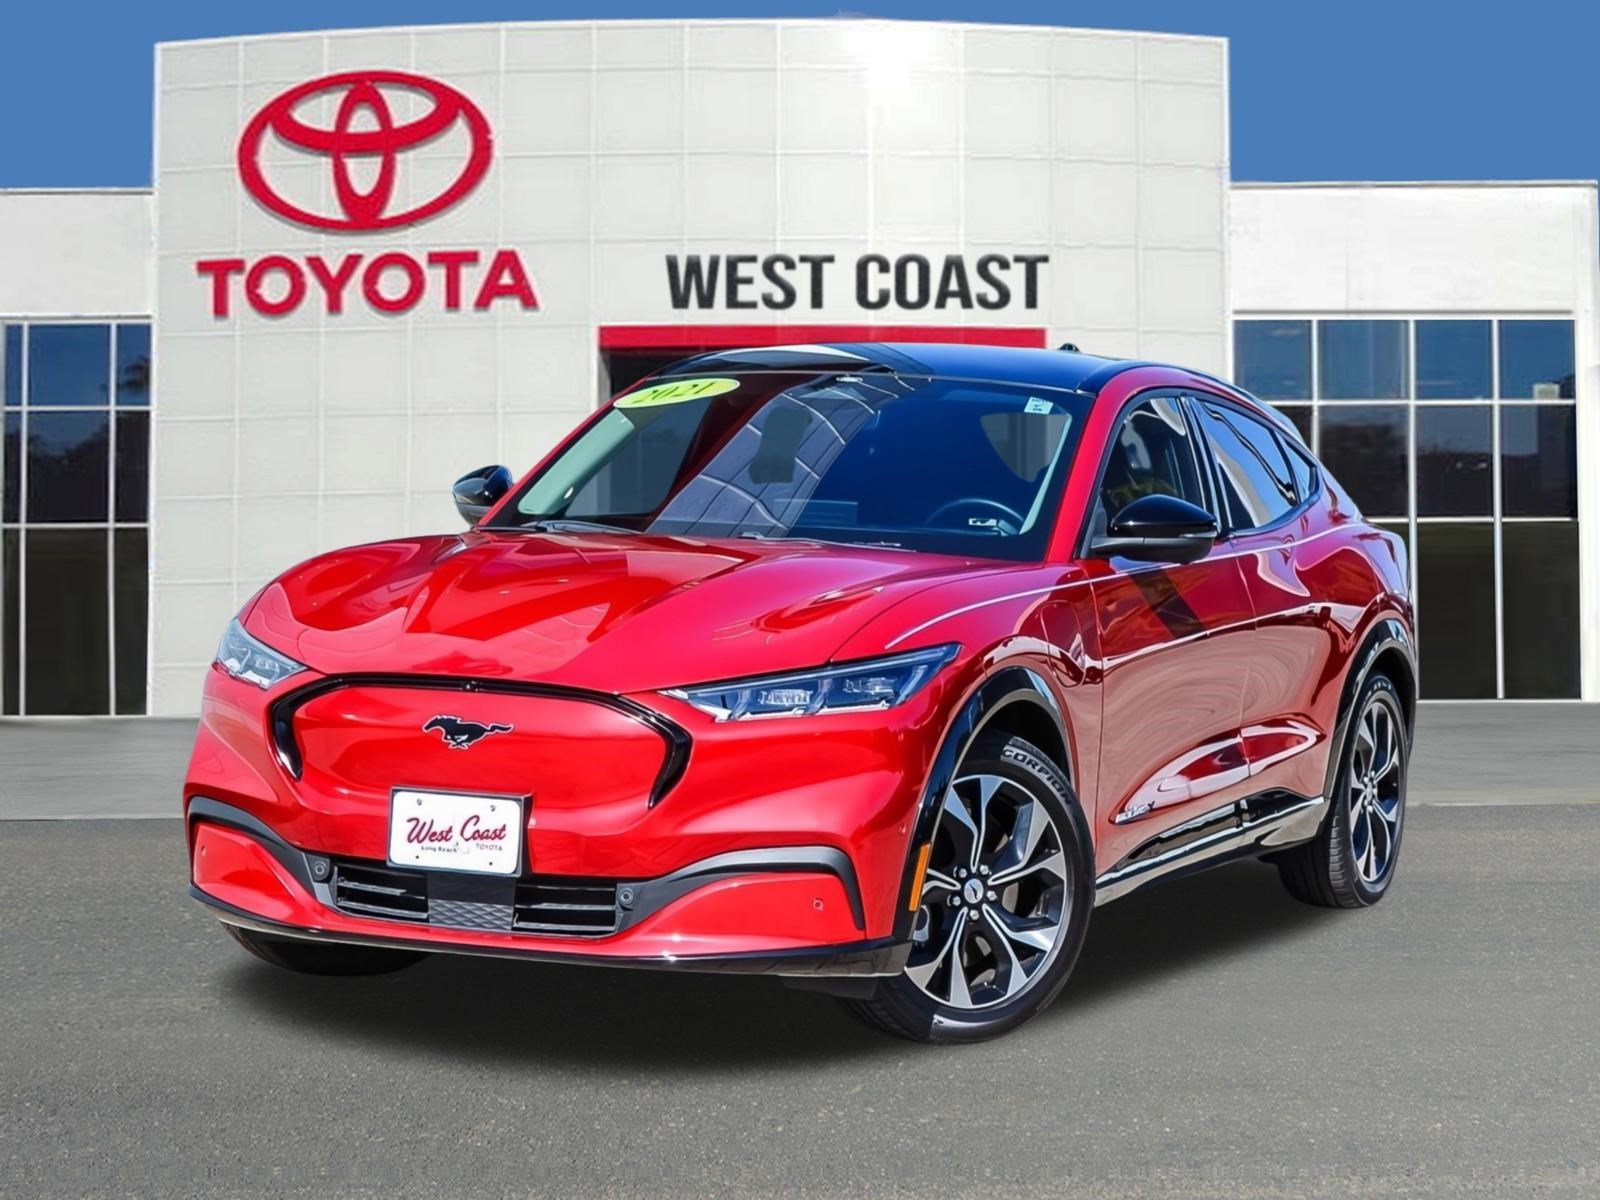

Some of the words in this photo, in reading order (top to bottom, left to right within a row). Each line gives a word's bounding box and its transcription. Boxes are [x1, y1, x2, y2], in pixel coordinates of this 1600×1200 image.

[196, 250, 539, 317] TOYOTA
[665, 253, 835, 310] WEST
[855, 253, 1050, 310] COAST
[631, 381, 716, 404] 2021
[406, 817, 453, 844] West
[460, 814, 507, 842] Coast
[475, 843, 503, 851] TOYOTA
